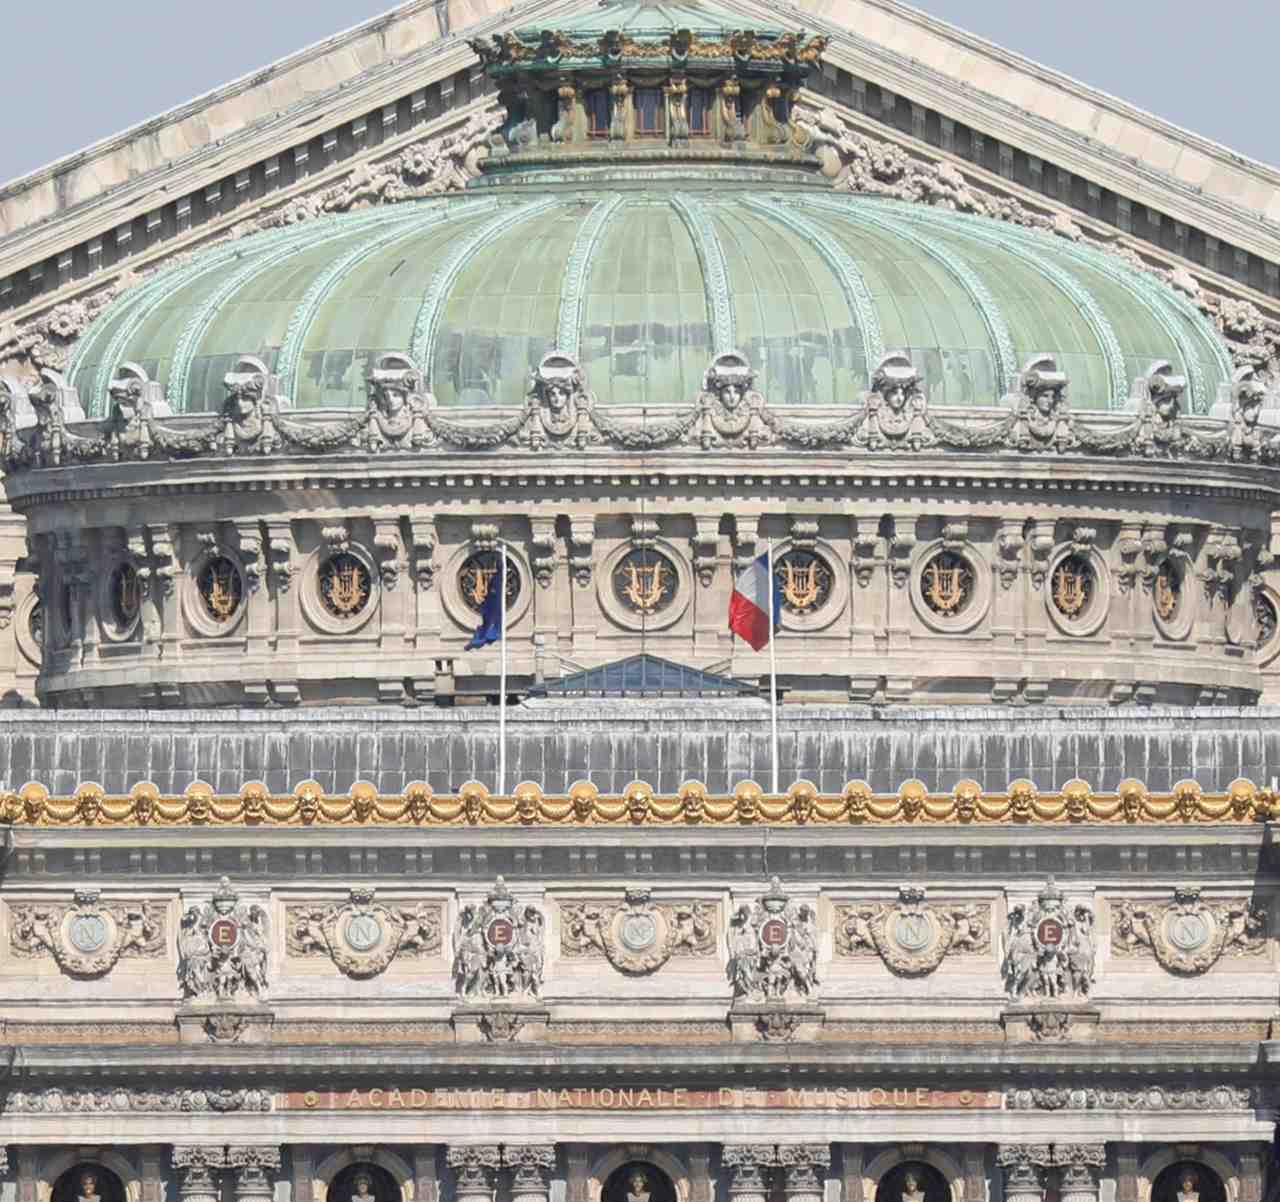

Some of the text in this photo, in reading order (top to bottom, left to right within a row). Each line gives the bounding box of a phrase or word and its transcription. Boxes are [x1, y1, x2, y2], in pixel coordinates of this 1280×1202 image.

[536, 1087, 688, 1107] NATIONALE
[719, 1087, 757, 1106] DE
[786, 1087, 929, 1107] MUSIQUE
